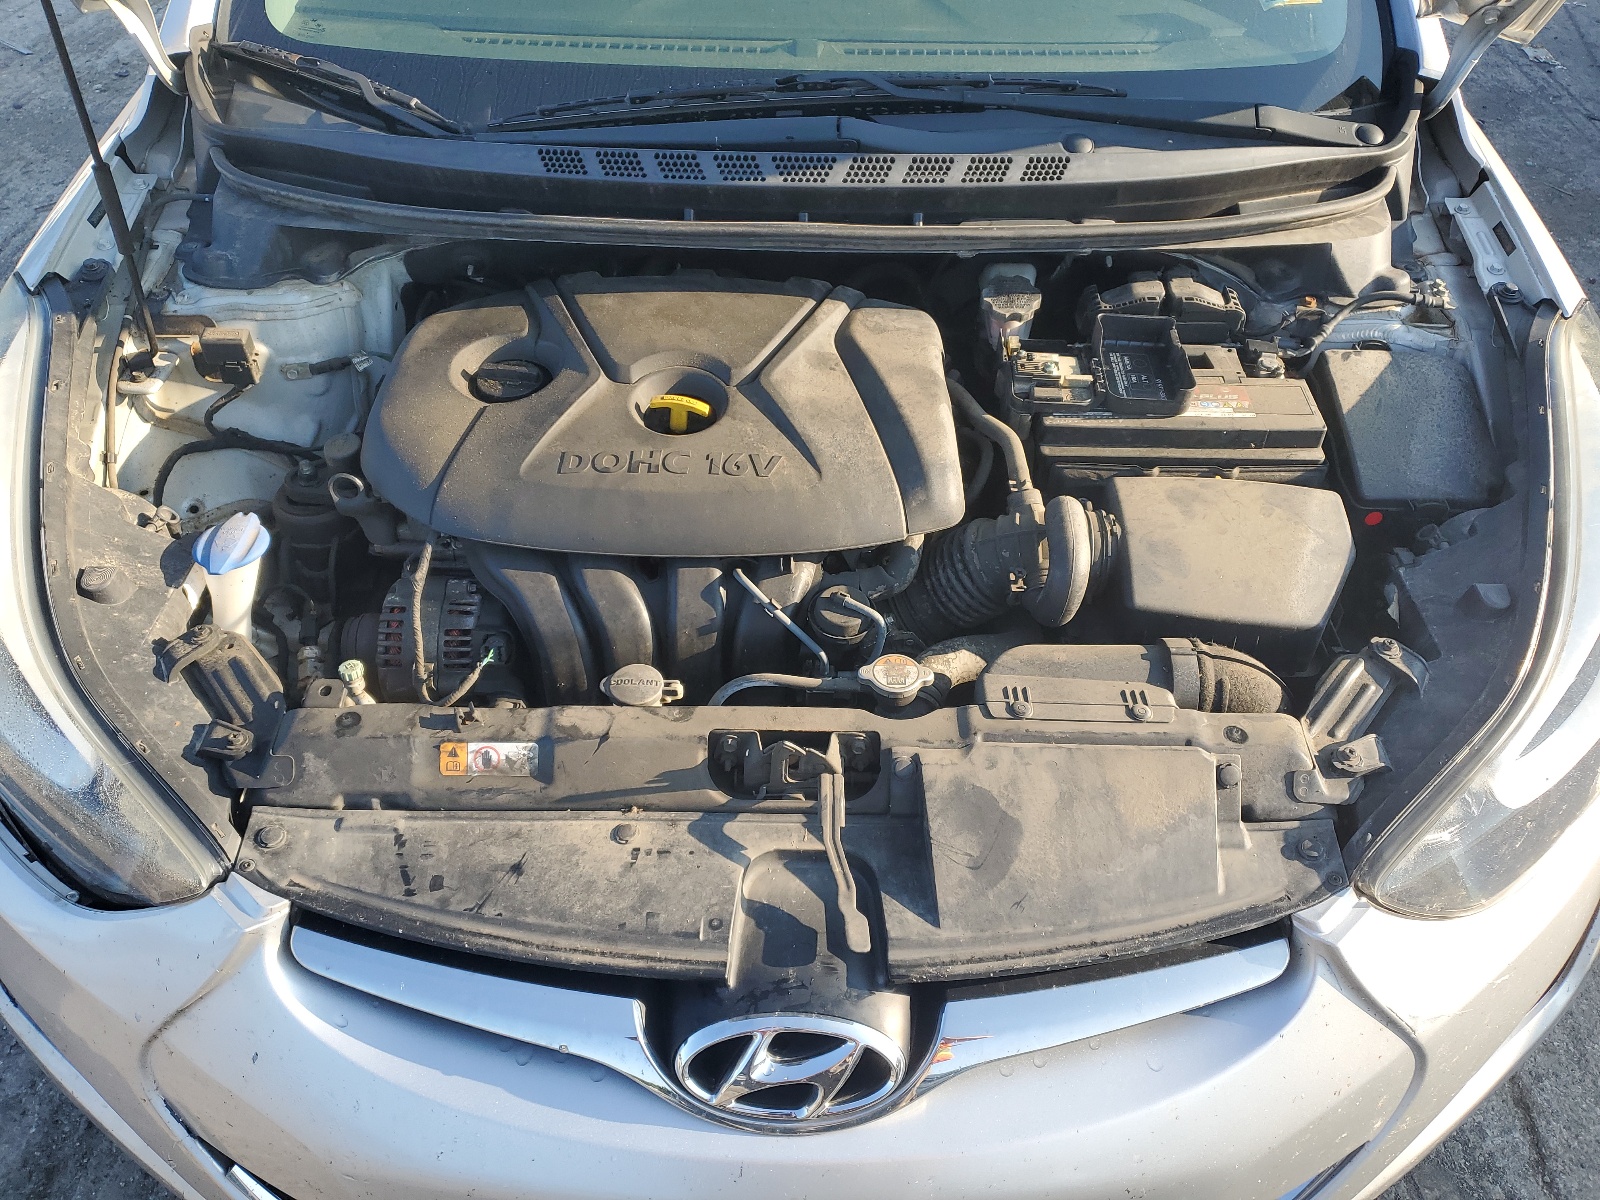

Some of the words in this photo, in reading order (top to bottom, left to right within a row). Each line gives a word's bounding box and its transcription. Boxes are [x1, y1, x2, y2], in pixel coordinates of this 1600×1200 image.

[556, 449, 691, 475] DOHC
[705, 451, 783, 478] 16V
[609, 677, 661, 687] COOLANT
